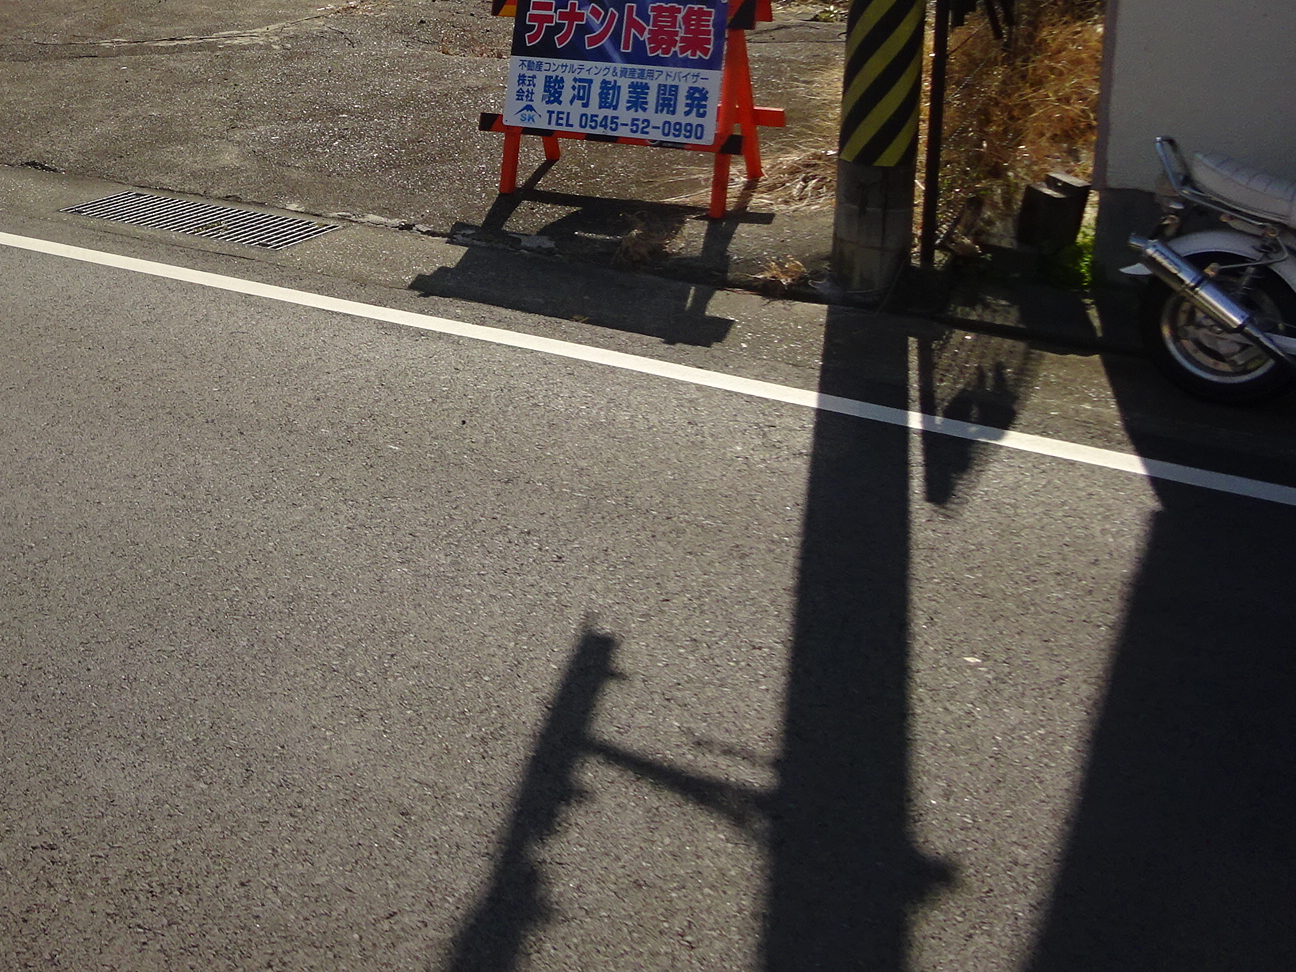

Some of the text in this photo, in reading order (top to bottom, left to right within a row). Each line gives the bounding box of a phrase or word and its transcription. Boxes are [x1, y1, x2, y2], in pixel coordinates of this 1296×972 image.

[524, 0, 715, 60] テナント募集
[517, 73, 537, 88] 株式
[515, 88, 536, 103] 会社
[541, 75, 709, 118] 駿河勧業開発
[519, 114, 536, 124] SK
[546, 110, 705, 141] TEL 0545-52-0990
